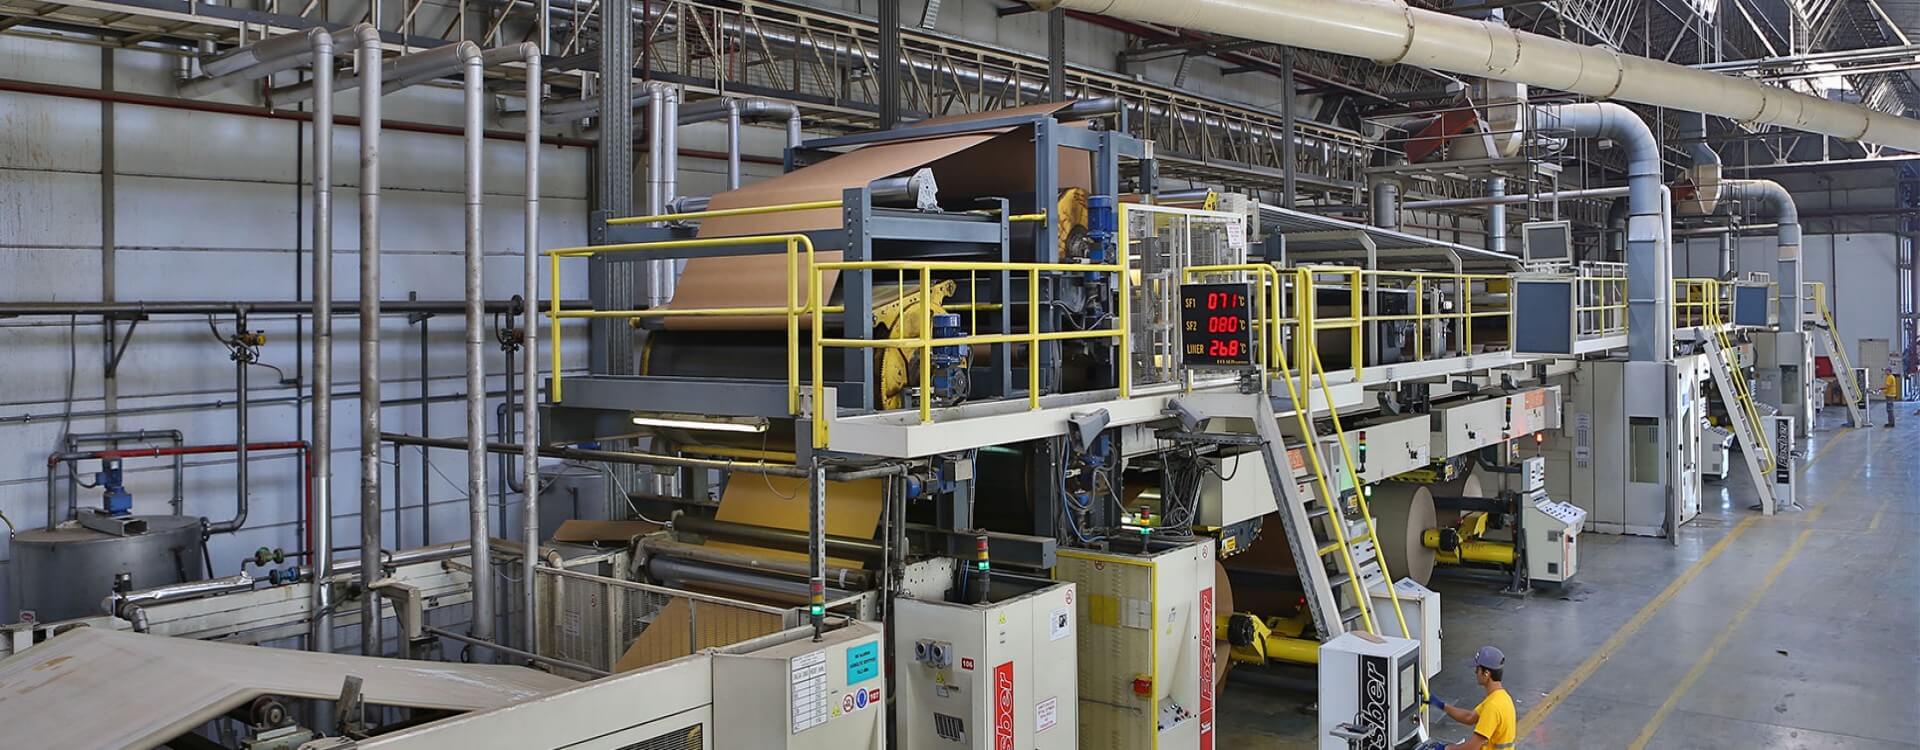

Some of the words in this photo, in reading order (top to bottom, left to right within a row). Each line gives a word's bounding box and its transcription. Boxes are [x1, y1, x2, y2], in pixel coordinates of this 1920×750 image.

[1207, 292, 1238, 310] 071
[1186, 320, 1197, 332] SF2
[1208, 316, 1238, 333] 080
[1186, 343, 1205, 355] LINER
[1209, 339, 1239, 356] 268
[1200, 594, 1213, 702] Fosber
[962, 660, 973, 668] 106
[1360, 661, 1386, 750] sber
